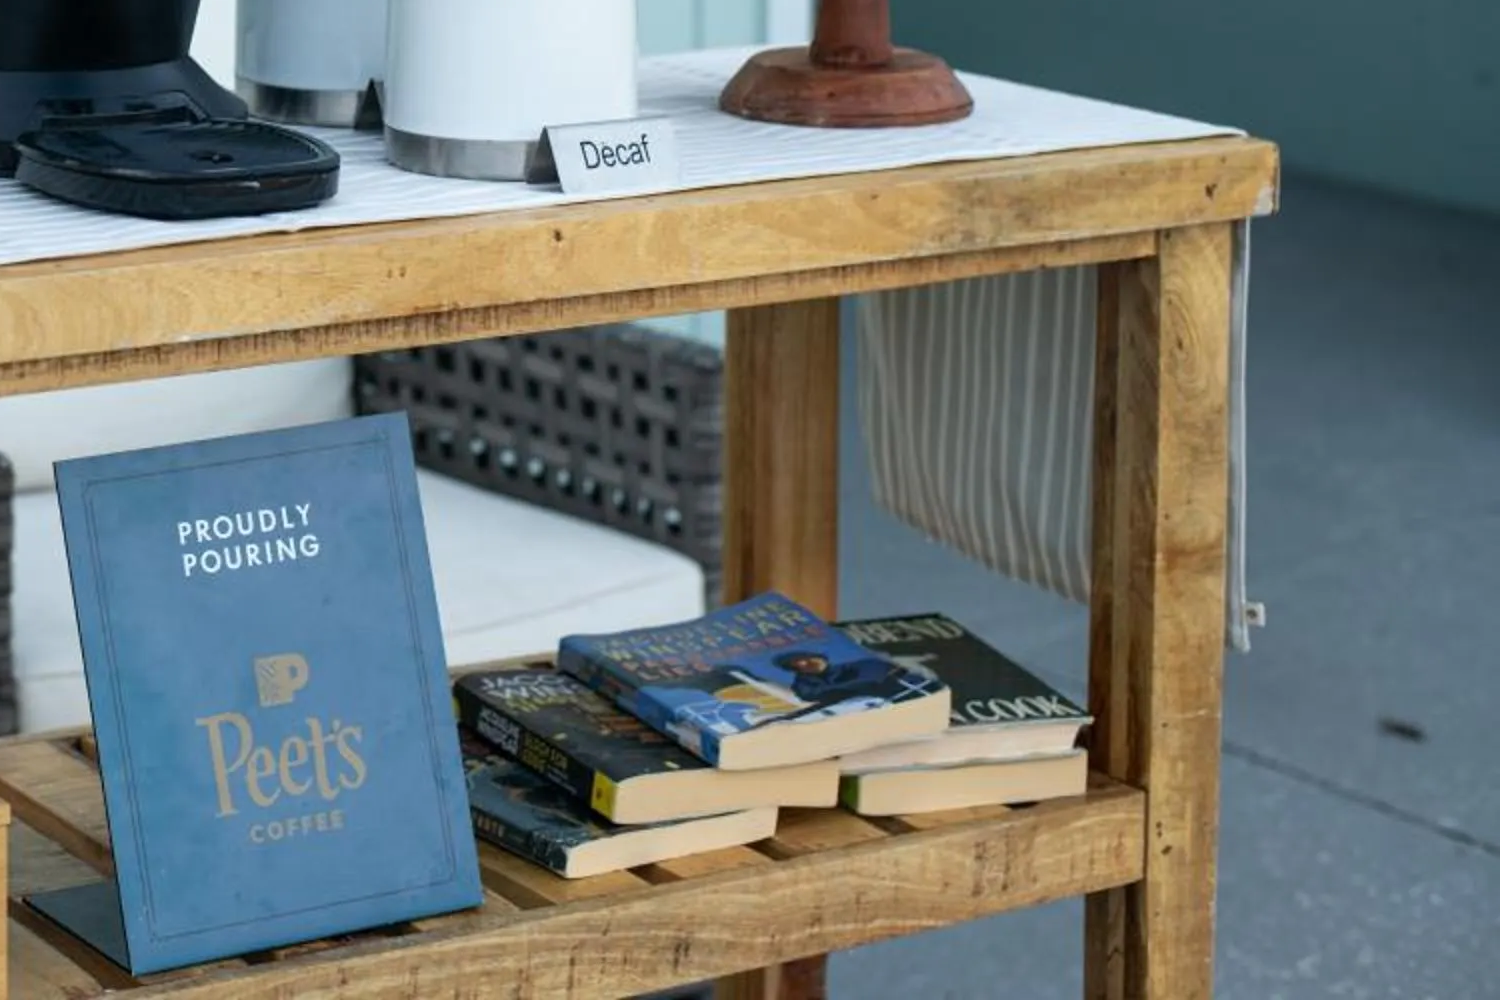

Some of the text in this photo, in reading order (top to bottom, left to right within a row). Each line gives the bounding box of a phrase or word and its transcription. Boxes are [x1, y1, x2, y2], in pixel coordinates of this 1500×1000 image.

[580, 133, 651, 170] Decaf
[177, 503, 312, 544] PROUDLY
[183, 535, 320, 577] POURING
[964, 695, 1081, 721] COOK
[196, 712, 367, 818] Peet's
[249, 810, 345, 844] COFFEE
